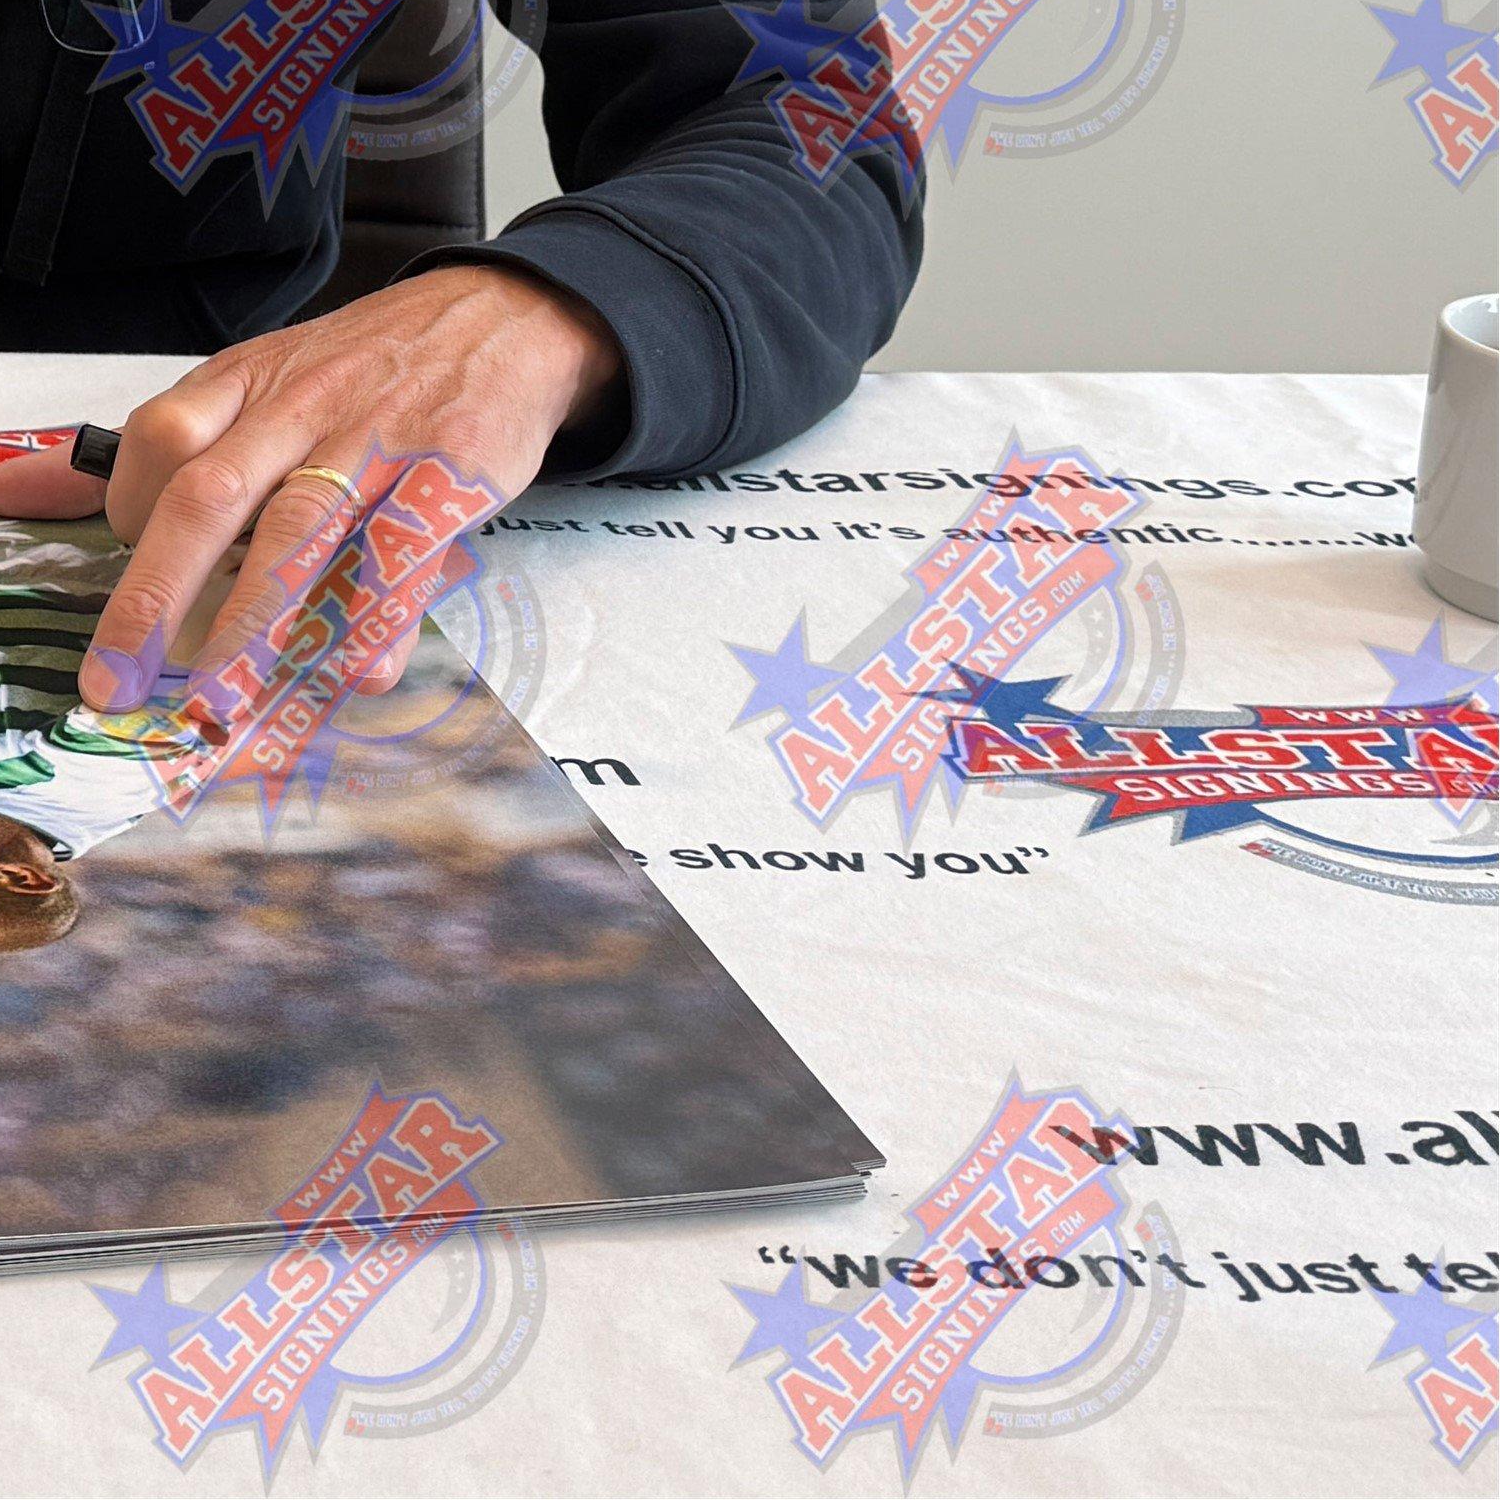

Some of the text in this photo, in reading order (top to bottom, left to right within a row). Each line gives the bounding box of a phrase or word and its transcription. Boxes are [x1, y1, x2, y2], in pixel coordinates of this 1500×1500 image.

[601, 520, 695, 540] tell
[708, 523, 821, 544] you
[834, 521, 926, 541] it’s
[950, 720, 1500, 778] ALLSTA
[670, 843, 866, 874] show
[1049, 1110, 1500, 1166] www.al
[1219, 1250, 1400, 1303] just
